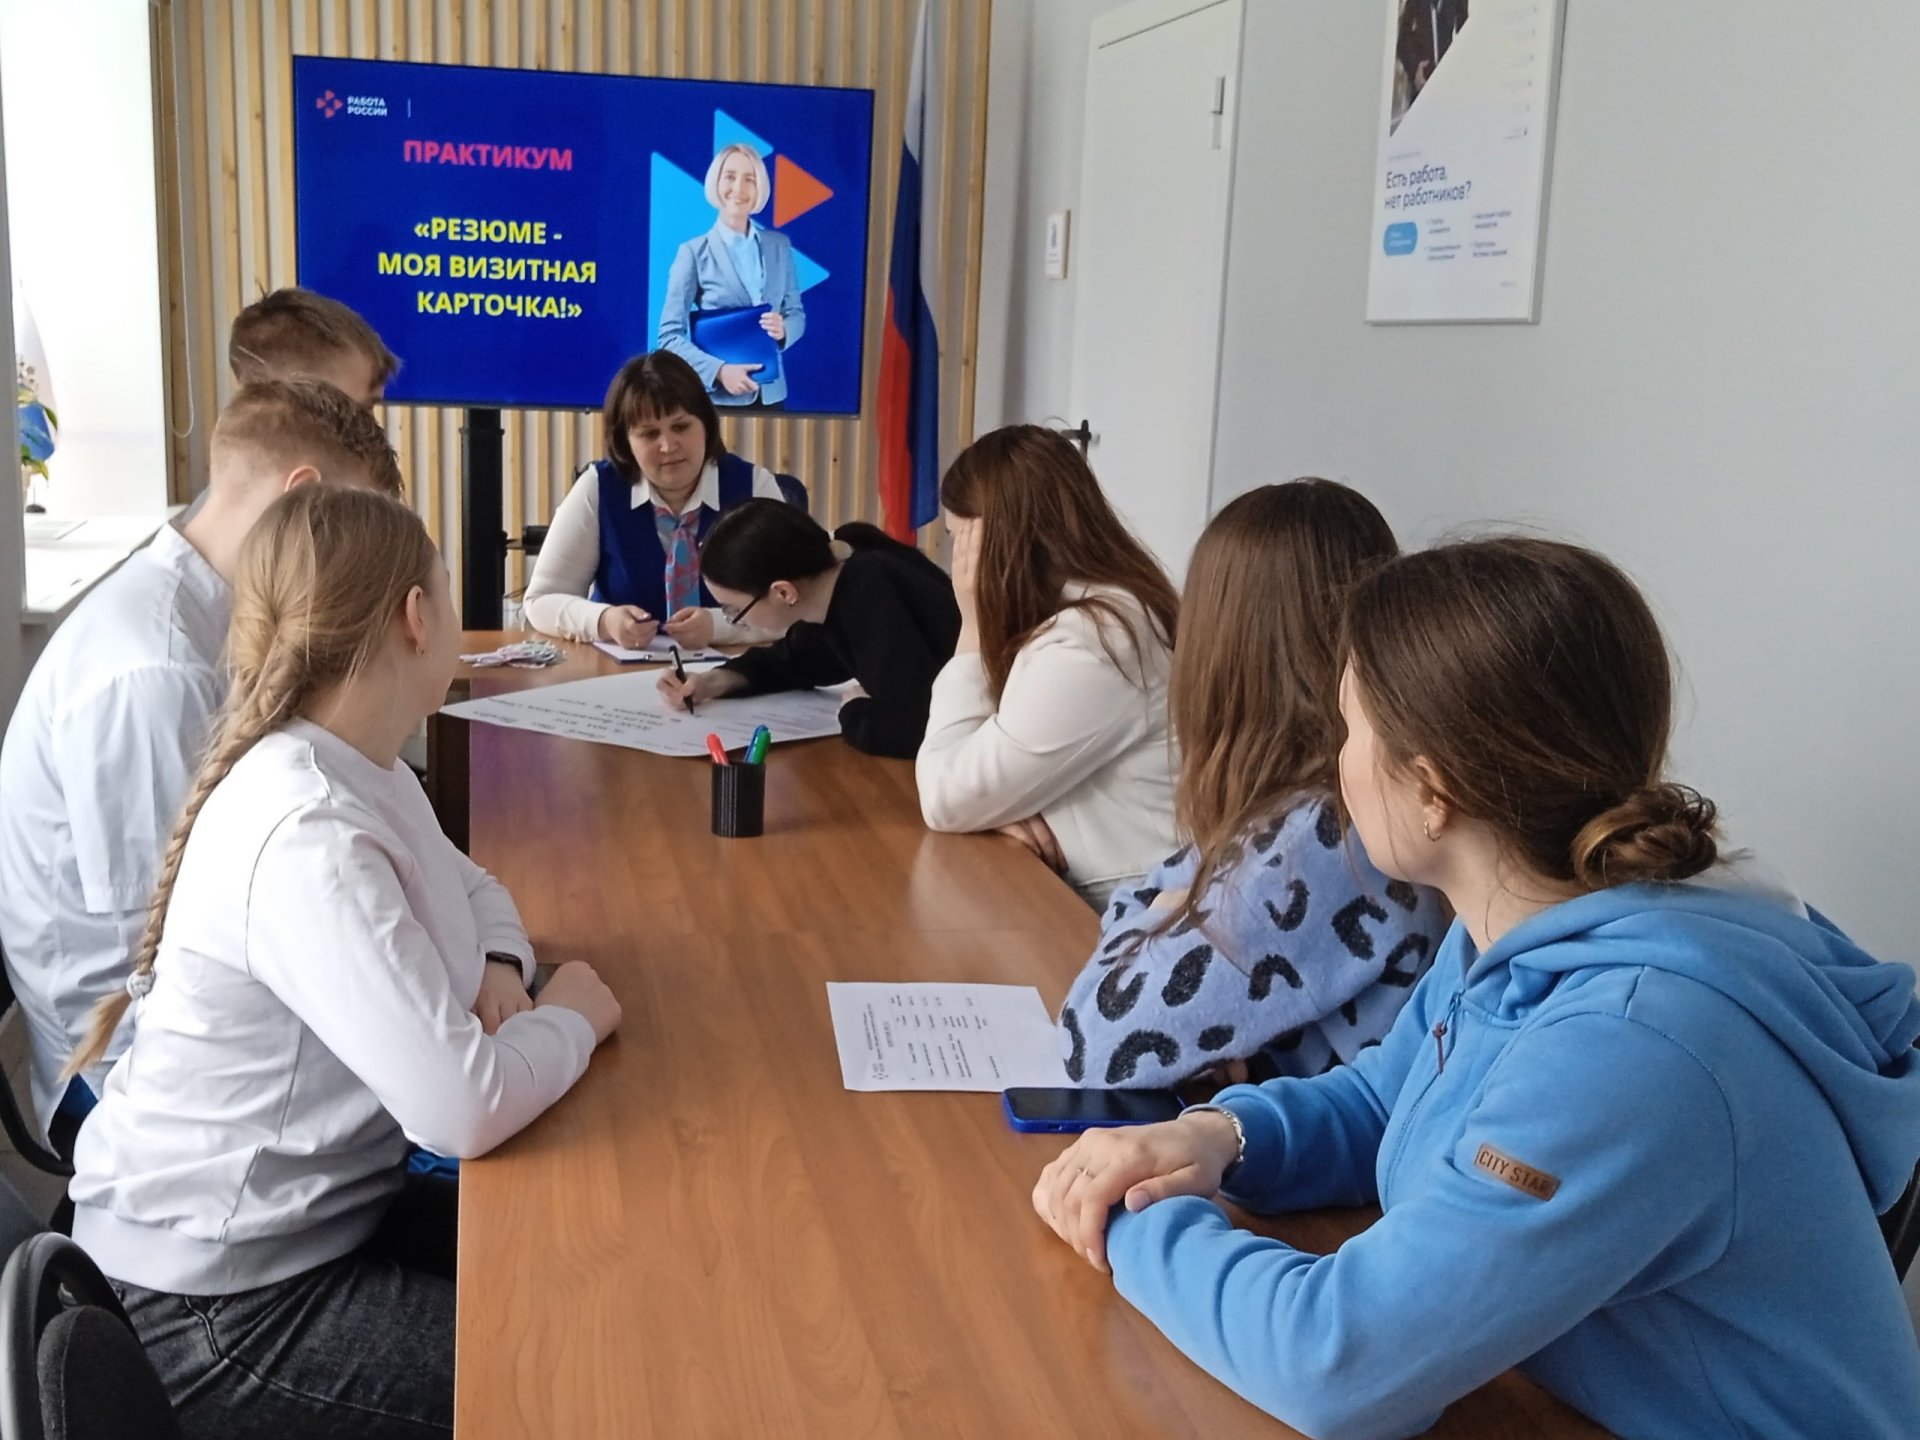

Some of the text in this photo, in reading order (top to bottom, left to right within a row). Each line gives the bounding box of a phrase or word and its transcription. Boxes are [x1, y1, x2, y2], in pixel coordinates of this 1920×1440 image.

[347, 96, 386, 107] РАБОТА
[347, 106, 388, 116] РОССИИ
[404, 140, 573, 171] ПРАКТИКУМ
[1386, 170, 1408, 190] Есть
[1384, 181, 1472, 211] нет работников?
[414, 218, 547, 245] «РЕЗЮМЕ
[378, 253, 596, 284] МОЯ ВИЗИТНАЯ
[417, 291, 583, 319] КАРТОЧКА!»
[1479, 1150, 1509, 1175] CITY
